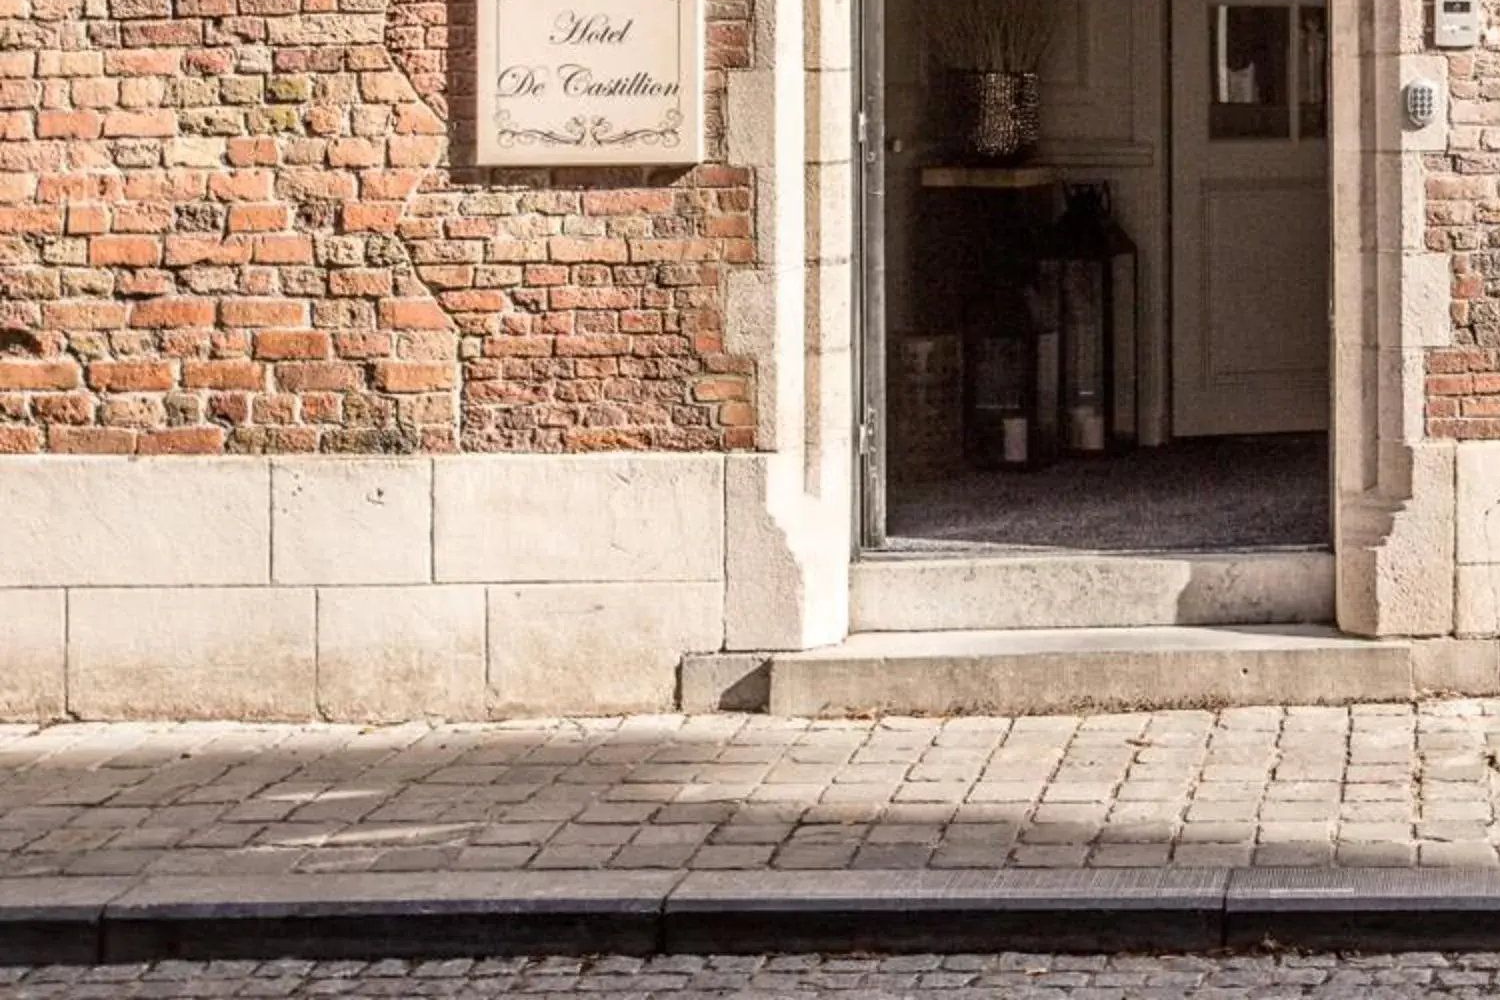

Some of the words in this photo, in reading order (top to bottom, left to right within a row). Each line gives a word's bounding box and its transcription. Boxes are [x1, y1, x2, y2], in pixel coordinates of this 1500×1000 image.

[549, 10, 633, 45] Hotel
[496, 64, 549, 98] De
[556, 63, 680, 98] Castillion
